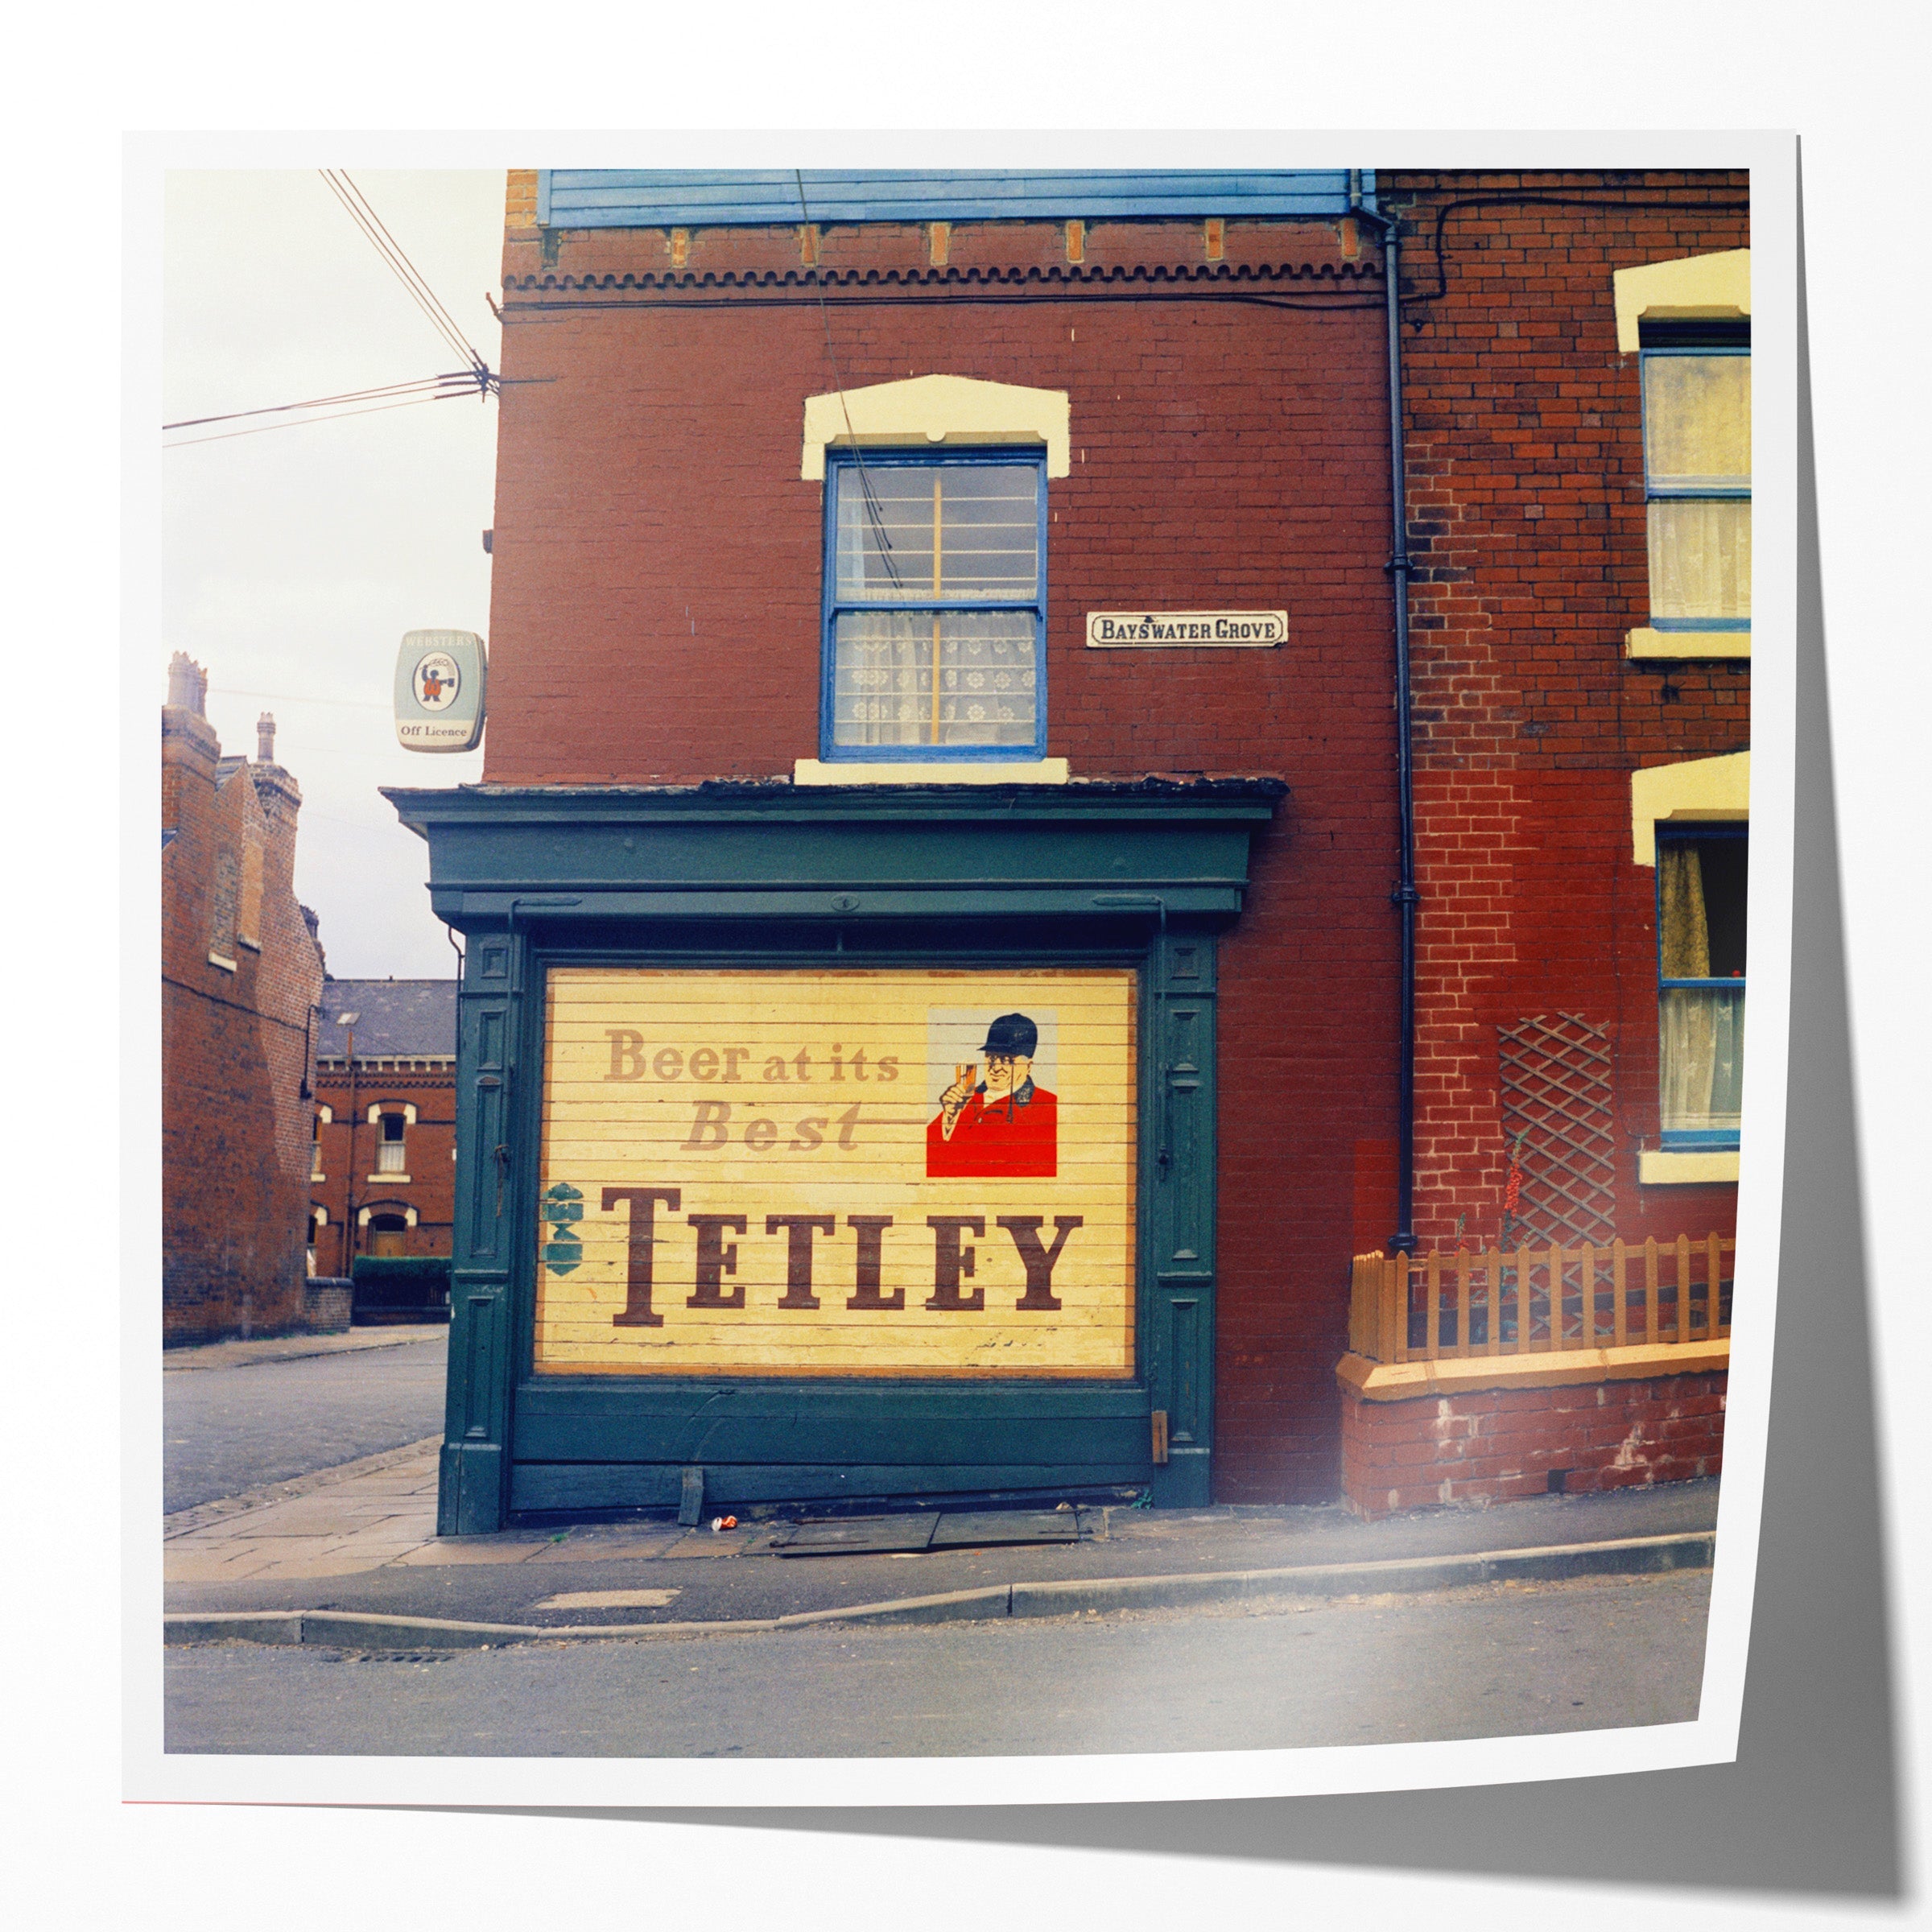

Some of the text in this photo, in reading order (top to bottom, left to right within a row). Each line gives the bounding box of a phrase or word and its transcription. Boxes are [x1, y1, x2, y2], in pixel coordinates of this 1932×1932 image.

[1101, 618, 1275, 639] BAYSWATER GROVE
[401, 726, 467, 737] Off Licence
[604, 1029, 899, 1082] Beer at its
[680, 1100, 863, 1152] Best
[601, 1187, 1084, 1327] TETLEY
